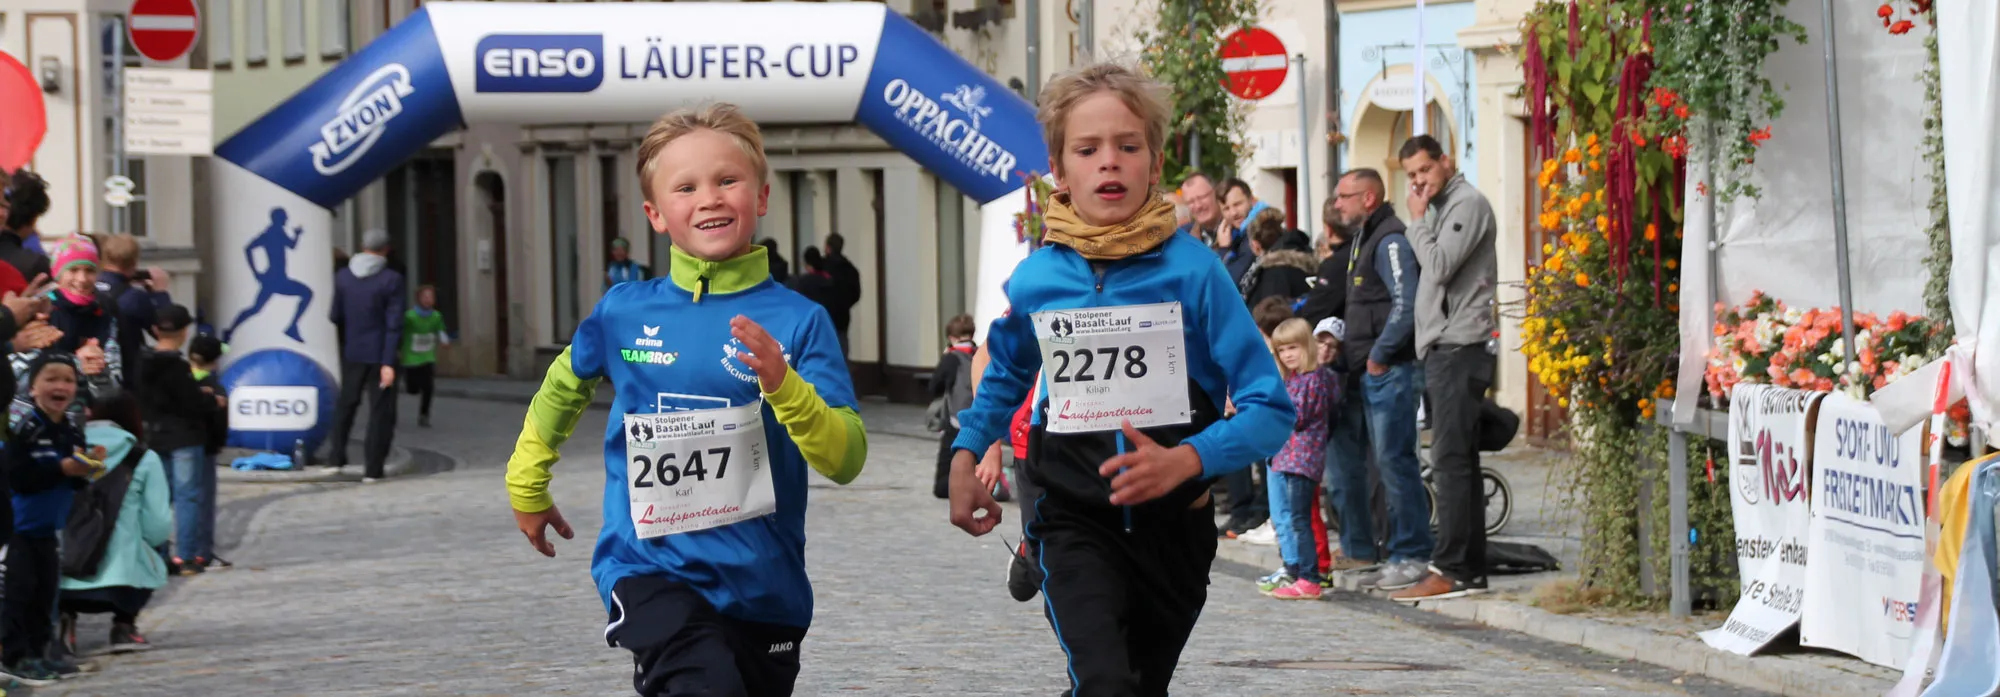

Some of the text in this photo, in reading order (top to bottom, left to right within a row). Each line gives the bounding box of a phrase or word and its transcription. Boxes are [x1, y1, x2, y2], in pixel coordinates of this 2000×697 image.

[619, 36, 859, 79] LÄUFER-CUP
[329, 94, 392, 145] ZVON
[883, 78, 1017, 184] OPPACHER
[1074, 311, 1112, 320] Stolpener
[1074, 316, 1132, 329] Basalt-Lauf
[635, 337, 663, 347] erima
[720, 357, 758, 383] BISCHOFS
[1052, 345, 1148, 383] 2278
[1168, 361, 1176, 375] km
[1086, 385, 1110, 395] Kilian
[654, 415, 695, 425] Stolpener
[1058, 399, 1153, 423] Laufsportladen
[655, 419, 715, 433] Basalt-Lauf
[1836, 417, 1900, 468] SPORT- UND
[633, 446, 732, 488] 2647
[675, 487, 693, 497] Karl
[1823, 468, 1919, 526] FREIZEITMARKT
[638, 503, 741, 525] Laufsportladen
[769, 641, 793, 653] JAKO
